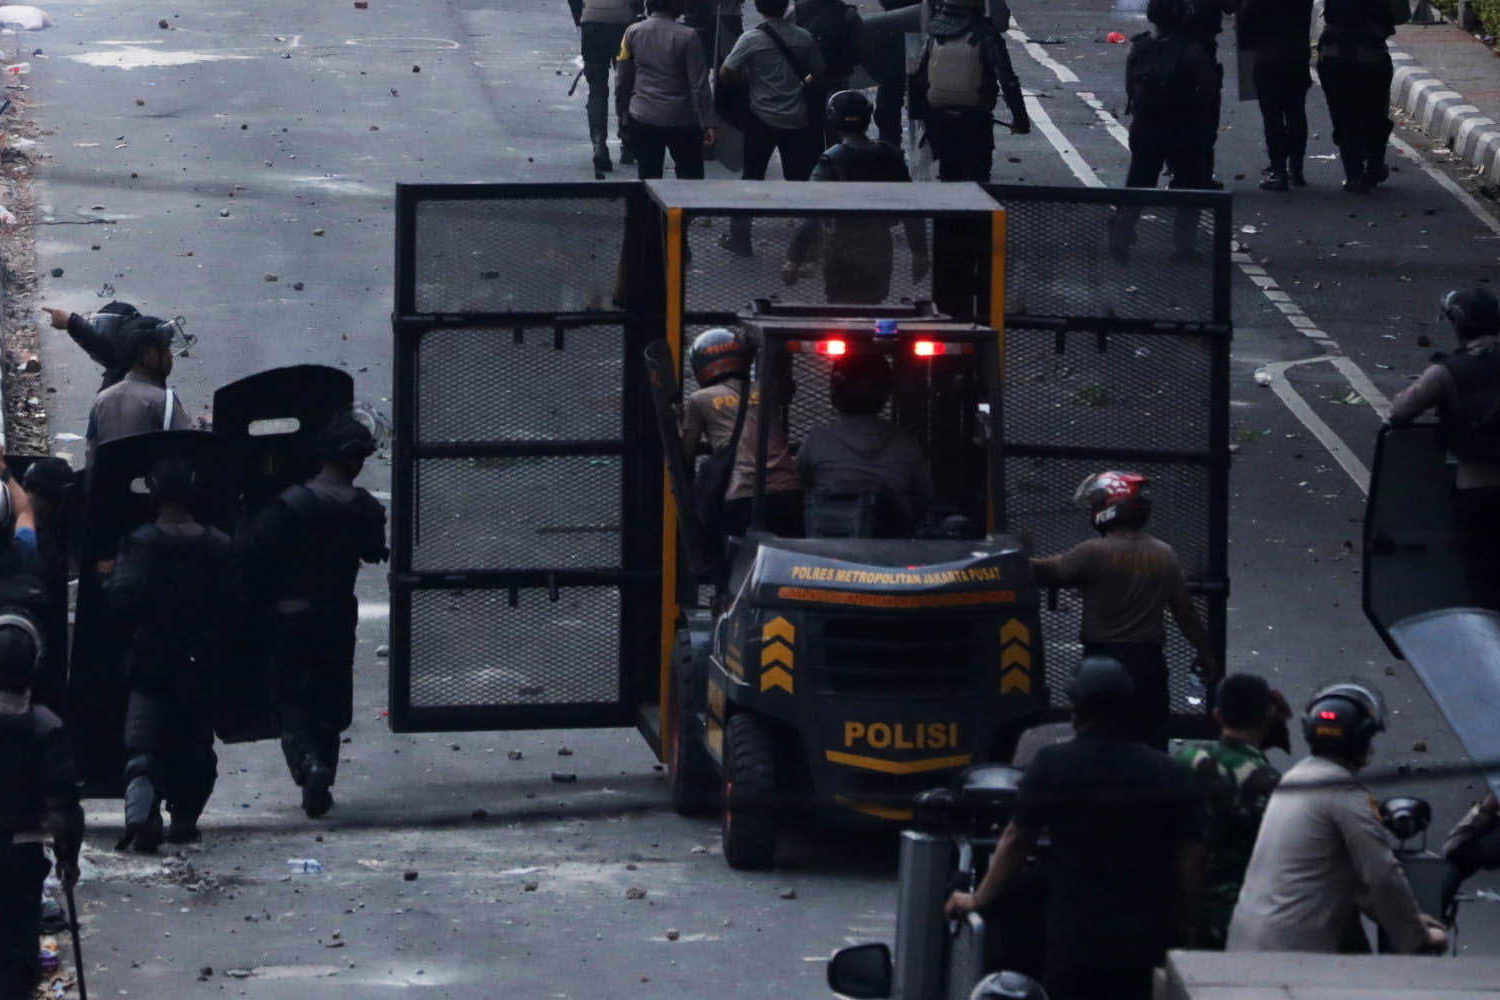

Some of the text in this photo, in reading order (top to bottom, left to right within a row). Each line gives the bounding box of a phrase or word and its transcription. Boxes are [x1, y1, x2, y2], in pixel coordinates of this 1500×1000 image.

[791, 566, 1000, 585] POLRES METROPOLITAN JAKARTA PUSAT
[843, 721, 958, 749] POLISI
